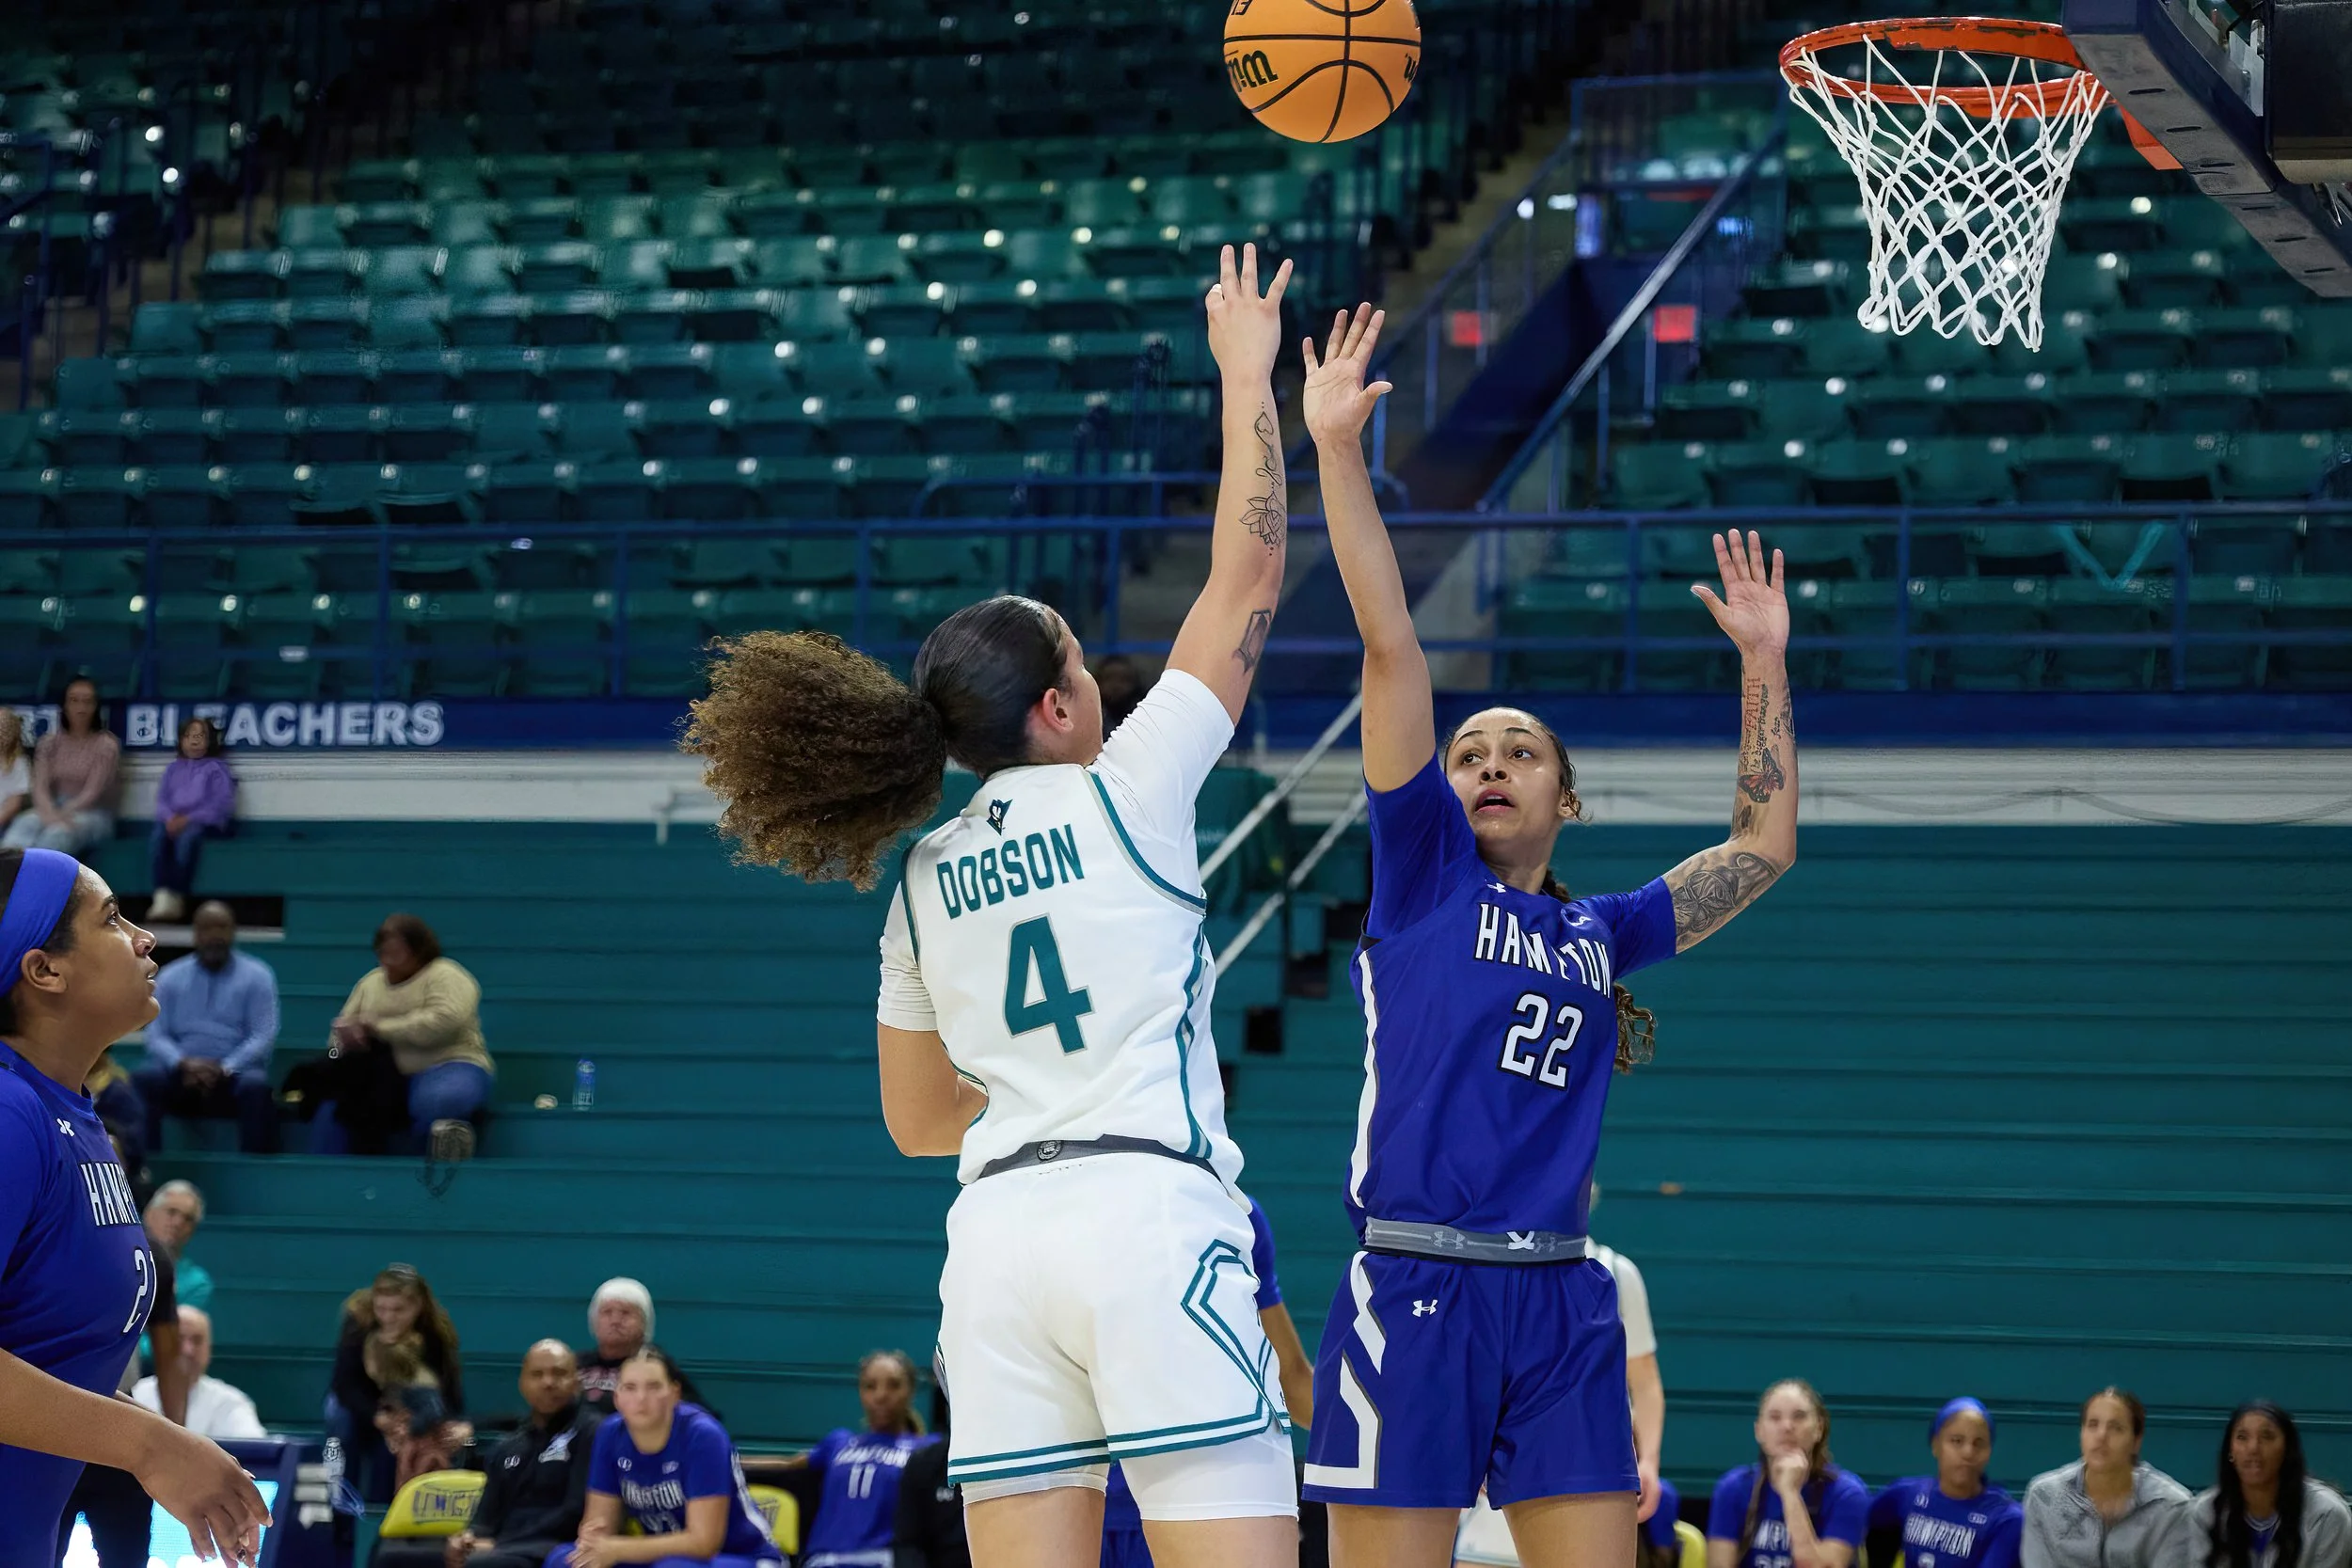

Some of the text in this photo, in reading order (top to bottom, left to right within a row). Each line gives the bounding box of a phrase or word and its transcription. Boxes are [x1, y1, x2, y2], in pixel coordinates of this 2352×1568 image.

[1745, 676, 1761, 731] FAITH
[936, 823, 1086, 920] DOBSON
[1002, 911, 1097, 1057] 4
[1500, 992, 1583, 1088] 22
[848, 1463, 877, 1499] 11
